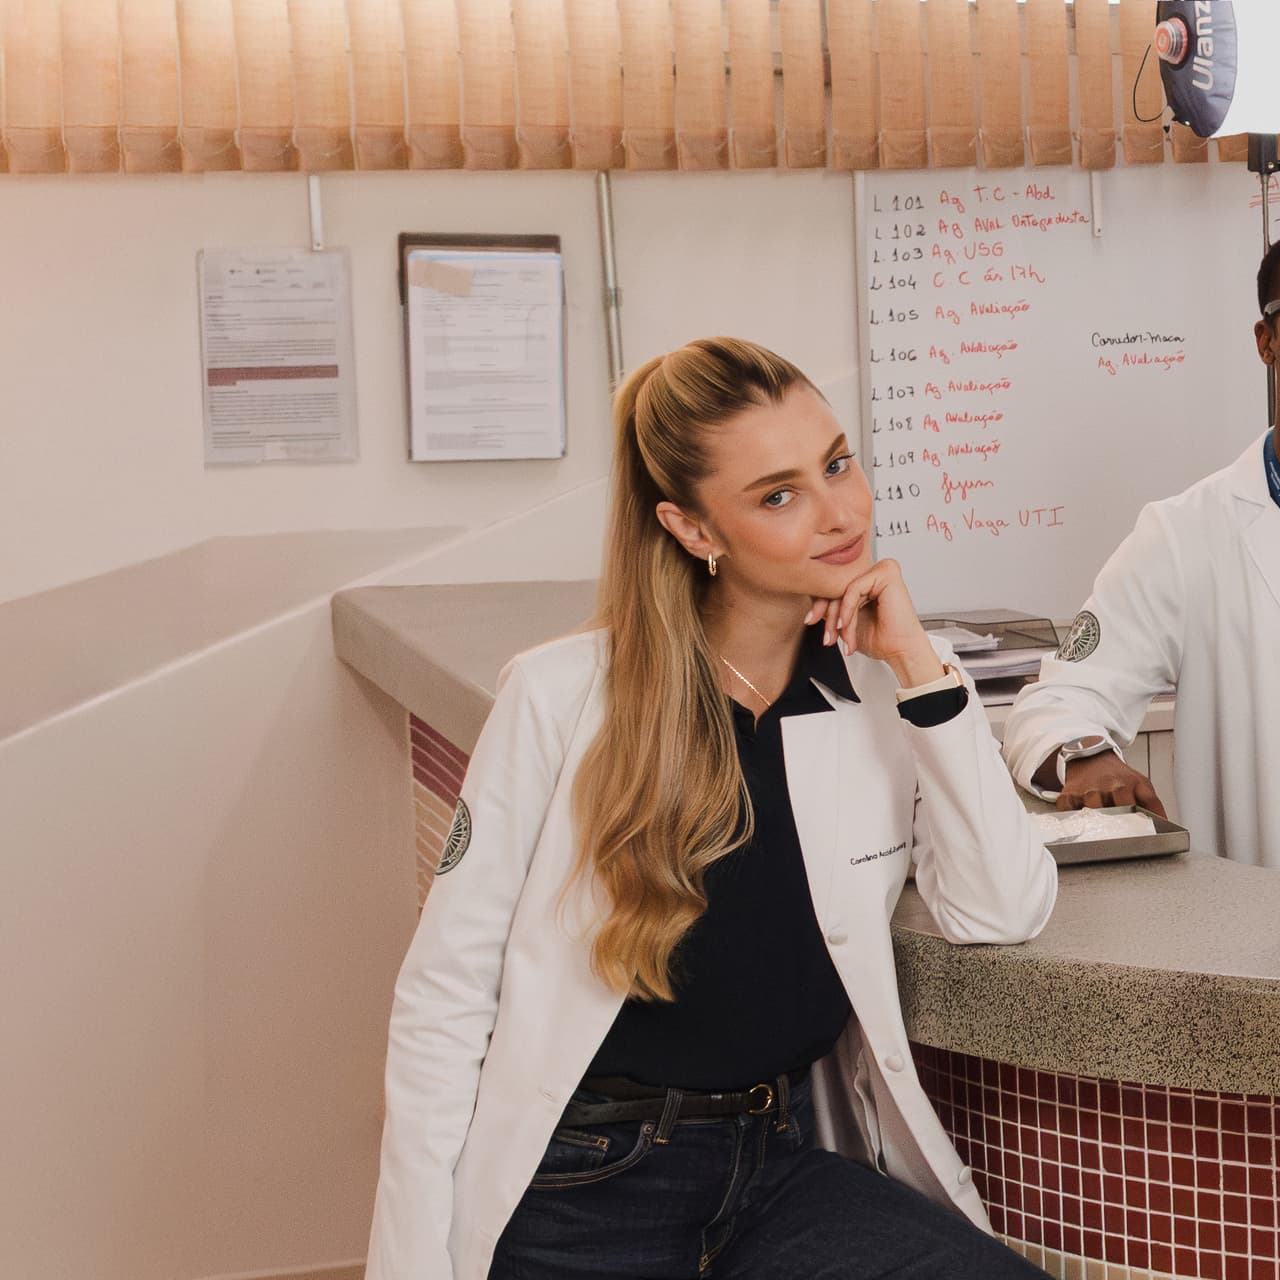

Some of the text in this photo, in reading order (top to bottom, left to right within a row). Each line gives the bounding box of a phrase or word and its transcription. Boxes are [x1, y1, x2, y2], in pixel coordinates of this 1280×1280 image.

[892, 195, 925, 211] 101
[891, 224, 927, 240] 102
[892, 248, 924, 262] 103
[964, 242, 1004, 260] USG
[888, 275, 917, 290] 104
[888, 308, 919, 322] 105
[890, 348, 918, 361] 106
[887, 386, 915, 400] 107
[888, 417, 913, 431] 108
[889, 451, 915, 468] 109
[888, 483, 921, 500] 110
[888, 520, 912, 537] 111
[962, 508, 1009, 536] Vaga
[1018, 506, 1065, 528] UTI
